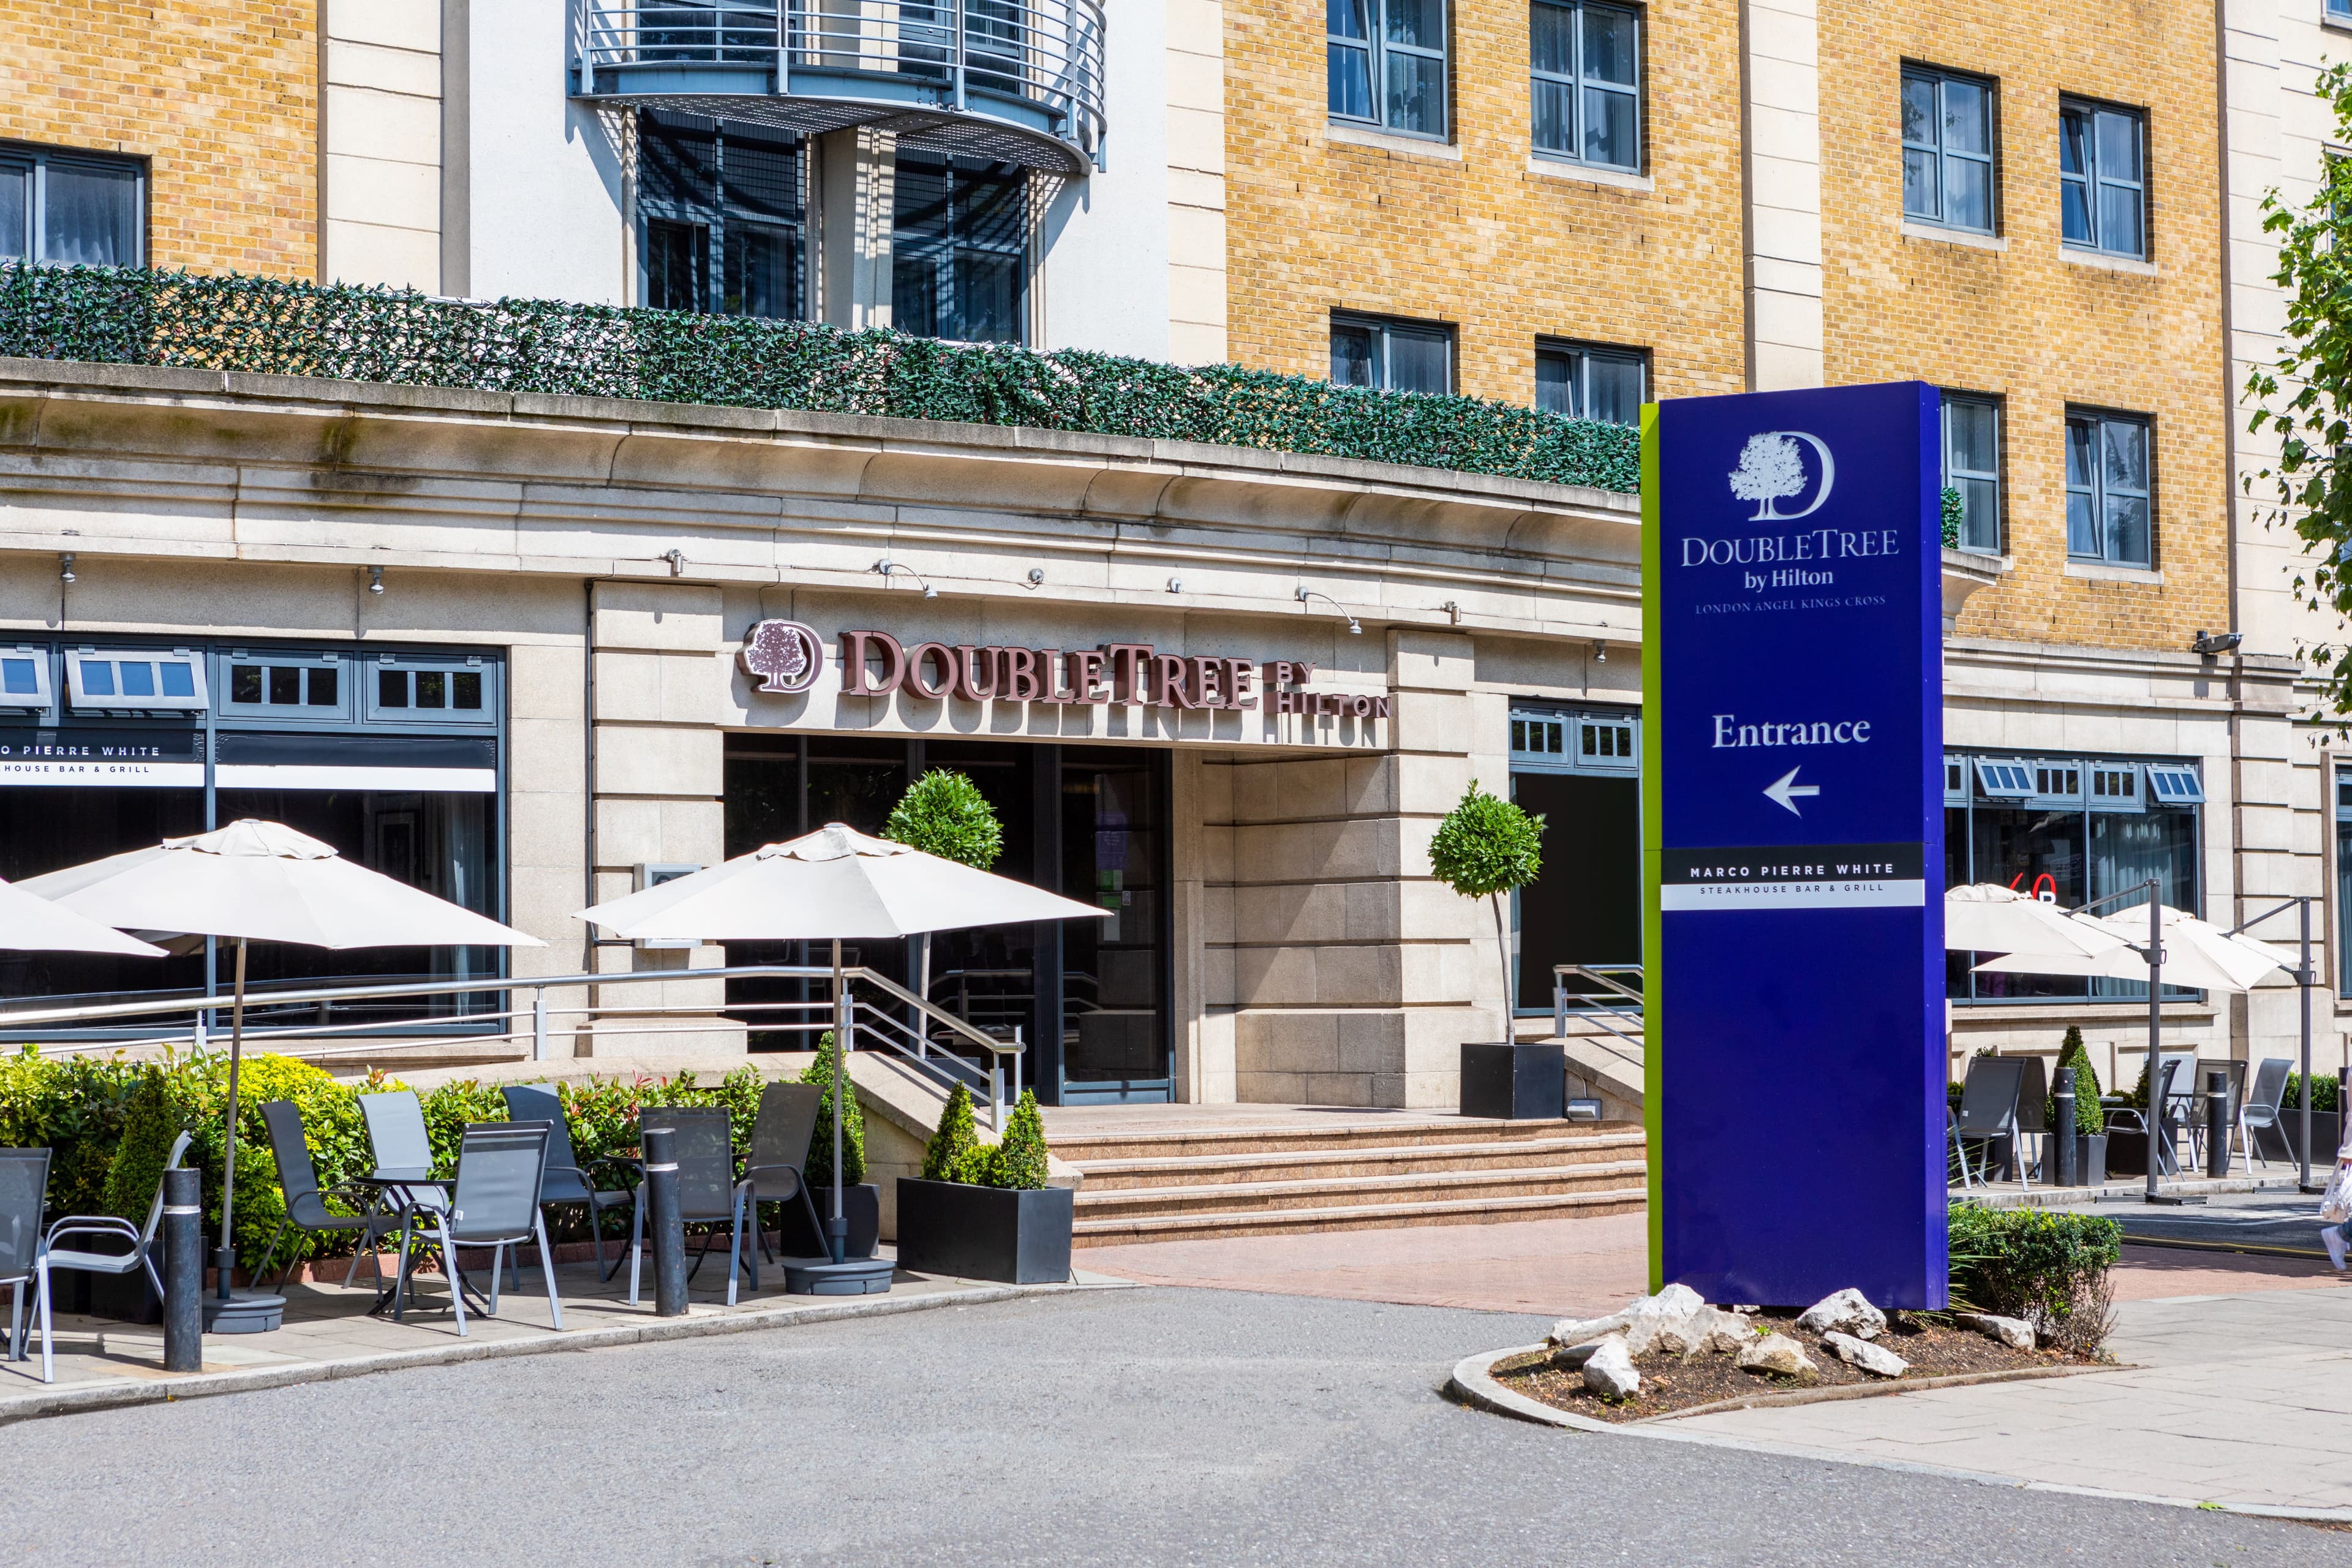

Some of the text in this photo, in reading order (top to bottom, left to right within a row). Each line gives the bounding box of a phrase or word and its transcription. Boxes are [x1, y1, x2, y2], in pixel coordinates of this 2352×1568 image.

[1681, 529, 1899, 567] DOUBLETREE
[1744, 568, 1834, 593] by Hilton
[1695, 595, 1887, 614] LONDON ANGEL KINGS CROSS
[839, 630, 1258, 710] DOUBLETREE
[1276, 660, 1318, 684] BY
[1276, 690, 1392, 718] HILTON
[1711, 714, 1871, 748] Entrance
[23, 745, 89, 756] PIERRE
[102, 747, 160, 756] WHITE
[1690, 864, 1894, 878] MARCO PIERRE WHITE
[1700, 886, 1787, 894] STEAKHOUSE
